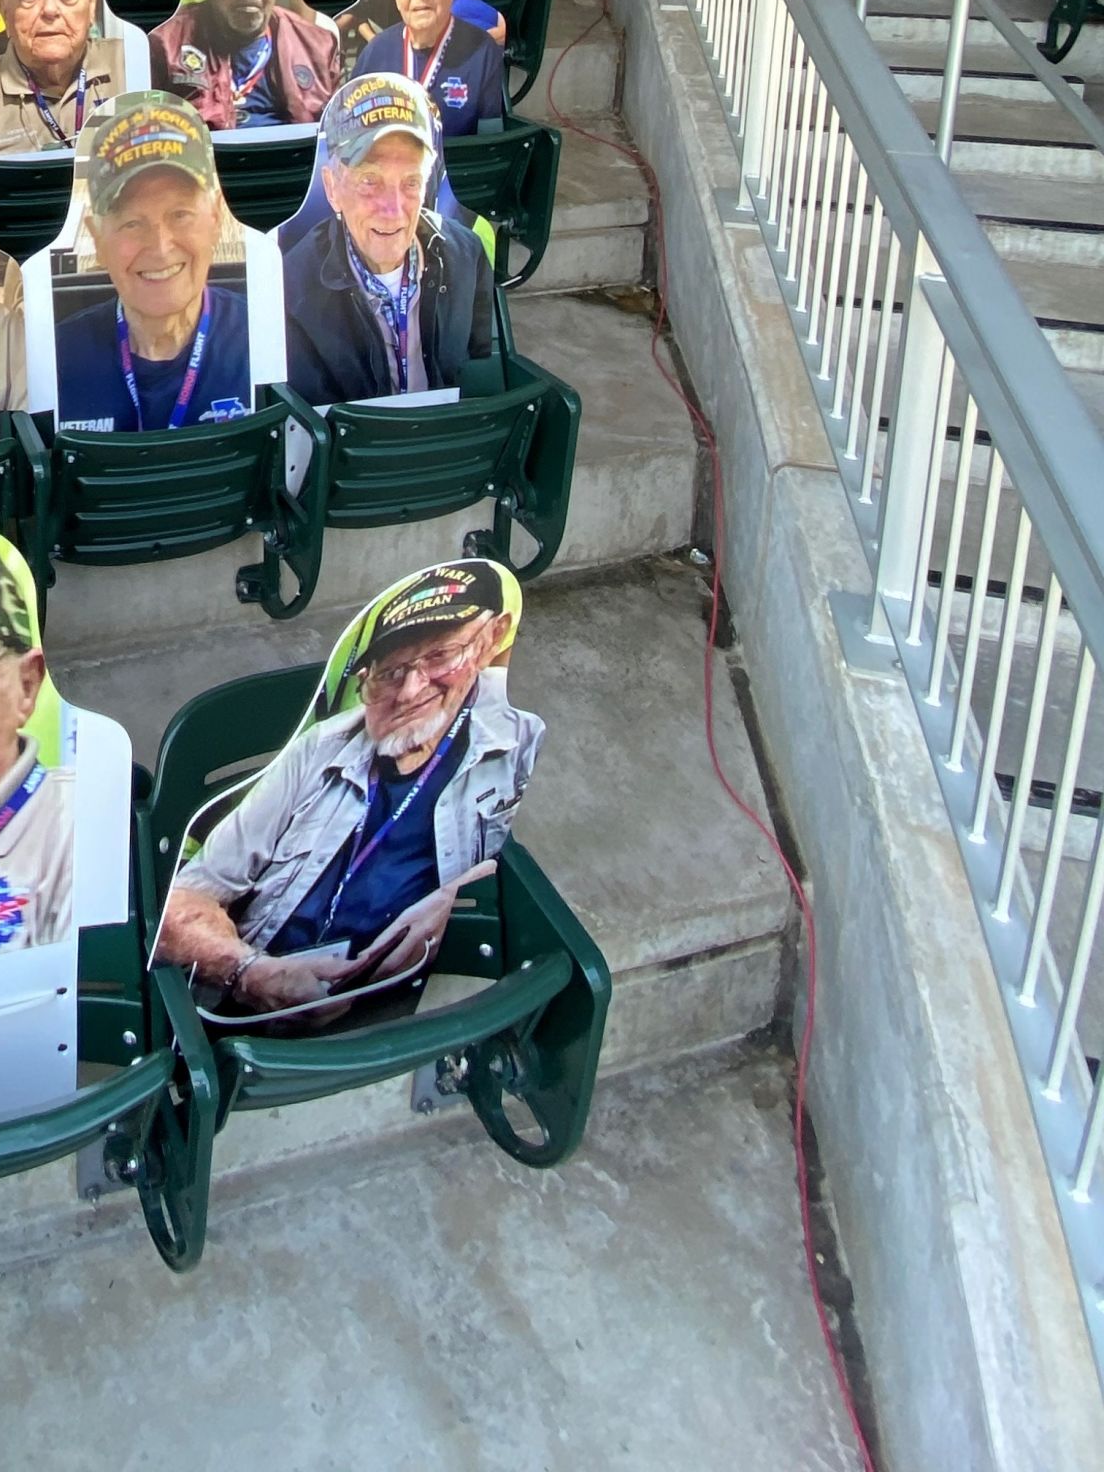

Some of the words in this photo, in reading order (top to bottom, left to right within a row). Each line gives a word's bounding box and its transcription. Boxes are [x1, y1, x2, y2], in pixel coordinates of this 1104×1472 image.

[343, 77, 386, 109] WORLD
[149, 109, 201, 143] KOREA
[361, 106, 414, 126] VETERAN
[114, 140, 183, 168] VETERAN
[399, 287, 408, 316] FLIGHT
[189, 331, 206, 369] FLIGHT
[125, 373, 140, 407] FLIGHT
[59, 417, 115, 433] VETERAN
[435, 567, 466, 581] WAR
[391, 593, 453, 625] VETERAN
[448, 707, 471, 740] FLIGHT
[391, 784, 421, 821] FLIGHT
